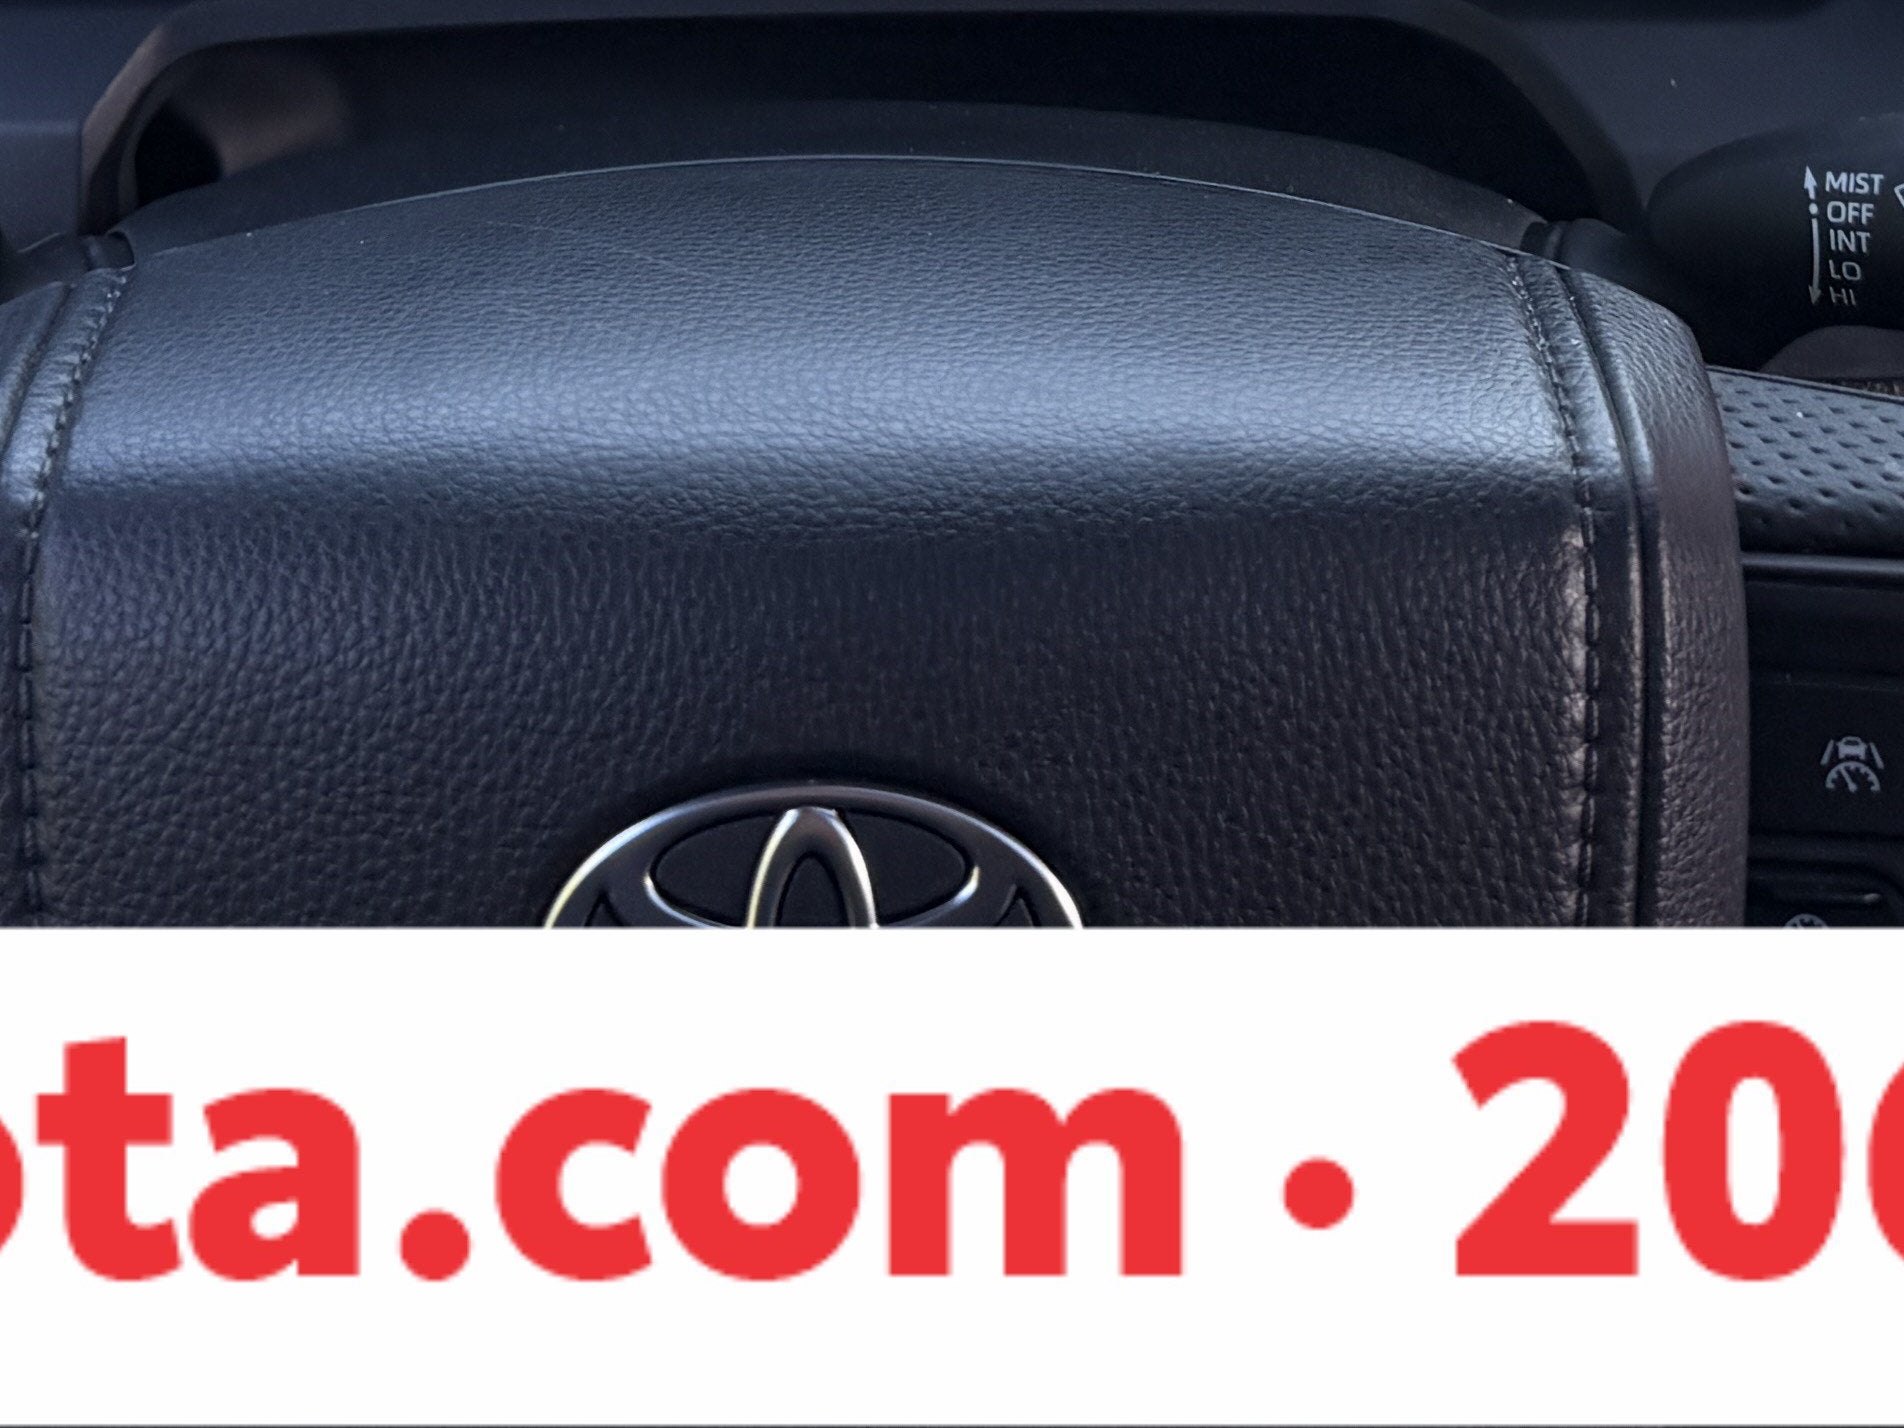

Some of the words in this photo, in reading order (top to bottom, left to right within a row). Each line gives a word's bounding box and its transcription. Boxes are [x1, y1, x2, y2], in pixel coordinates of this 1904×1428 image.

[1824, 170, 1884, 195] MIST
[1826, 200, 1875, 225] OFF
[1829, 229, 1872, 255] INT
[1829, 259, 1863, 282] LO
[1830, 286, 1857, 307] HI
